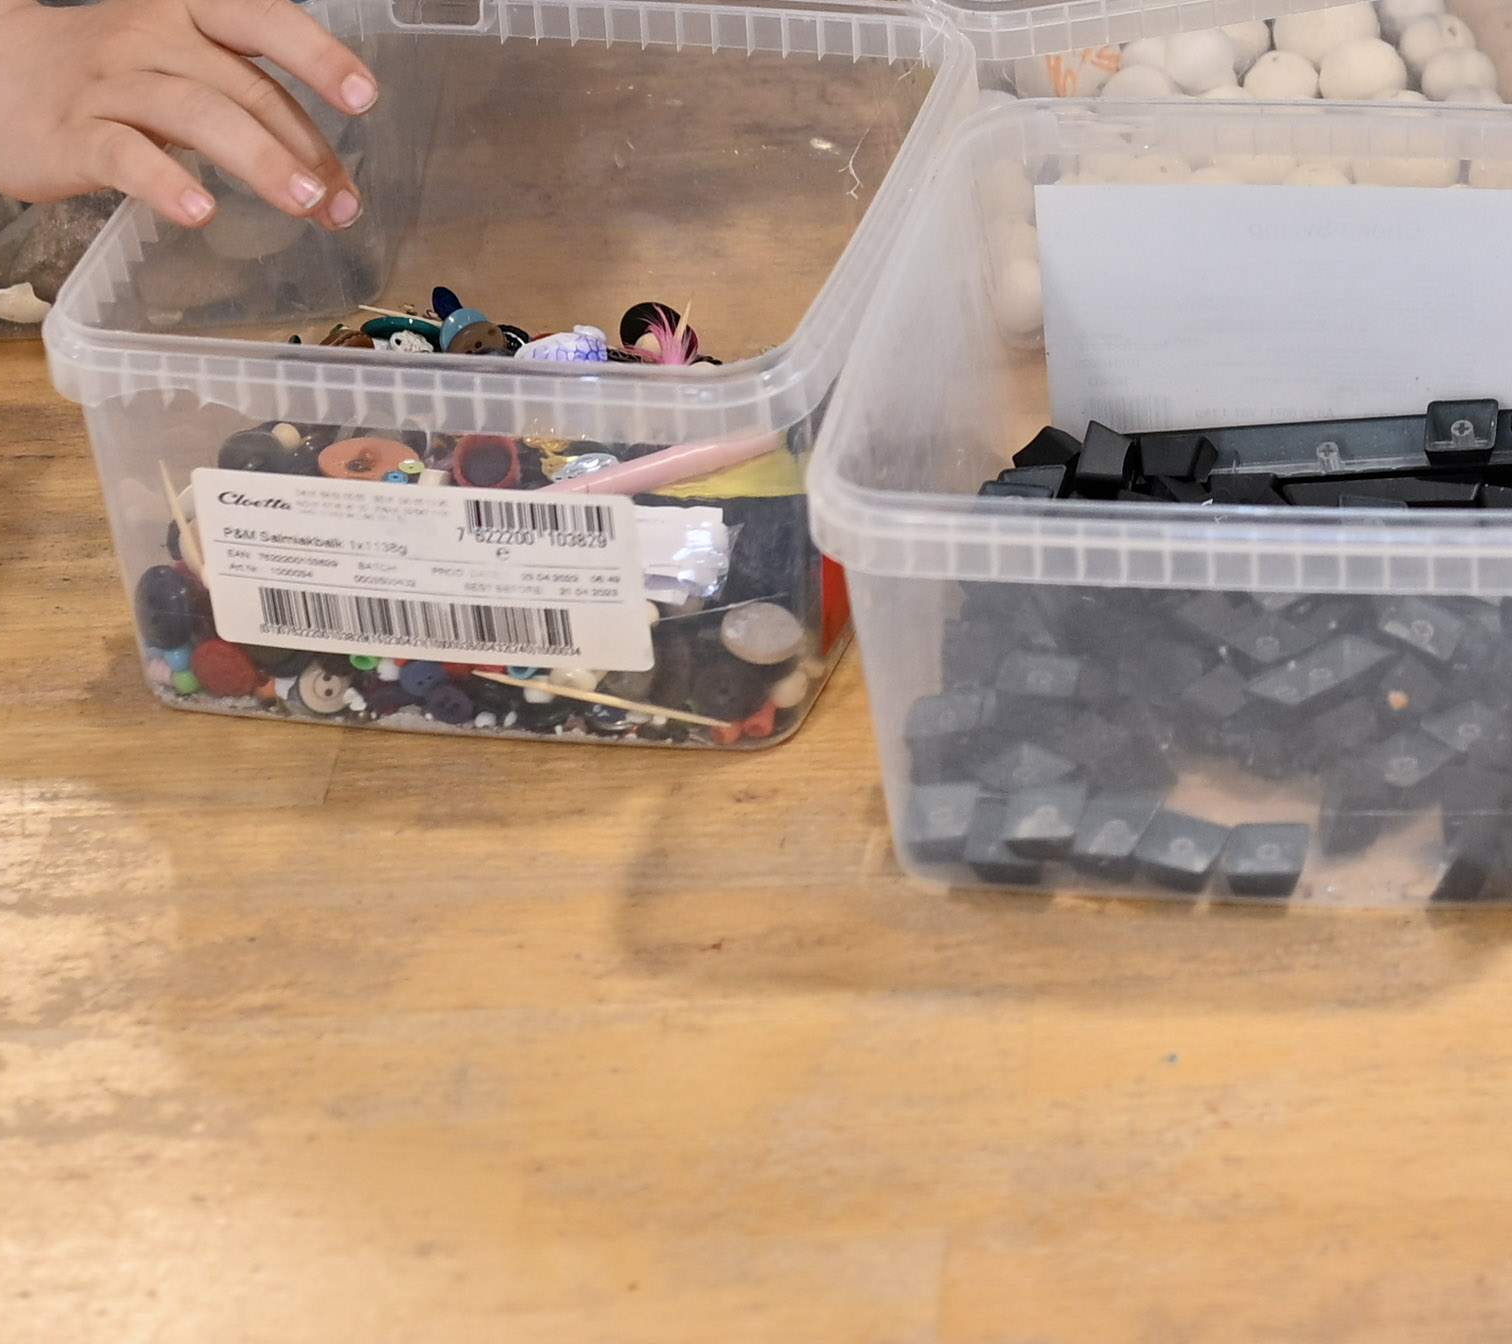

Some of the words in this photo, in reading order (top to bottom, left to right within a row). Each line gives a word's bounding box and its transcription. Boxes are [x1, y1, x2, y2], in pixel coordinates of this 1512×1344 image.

[217, 490, 292, 510] Cloetta
[223, 526, 257, 541] P&M
[455, 526, 465, 542] 7
[474, 529, 535, 546] 622200
[548, 531, 608, 549] 103829
